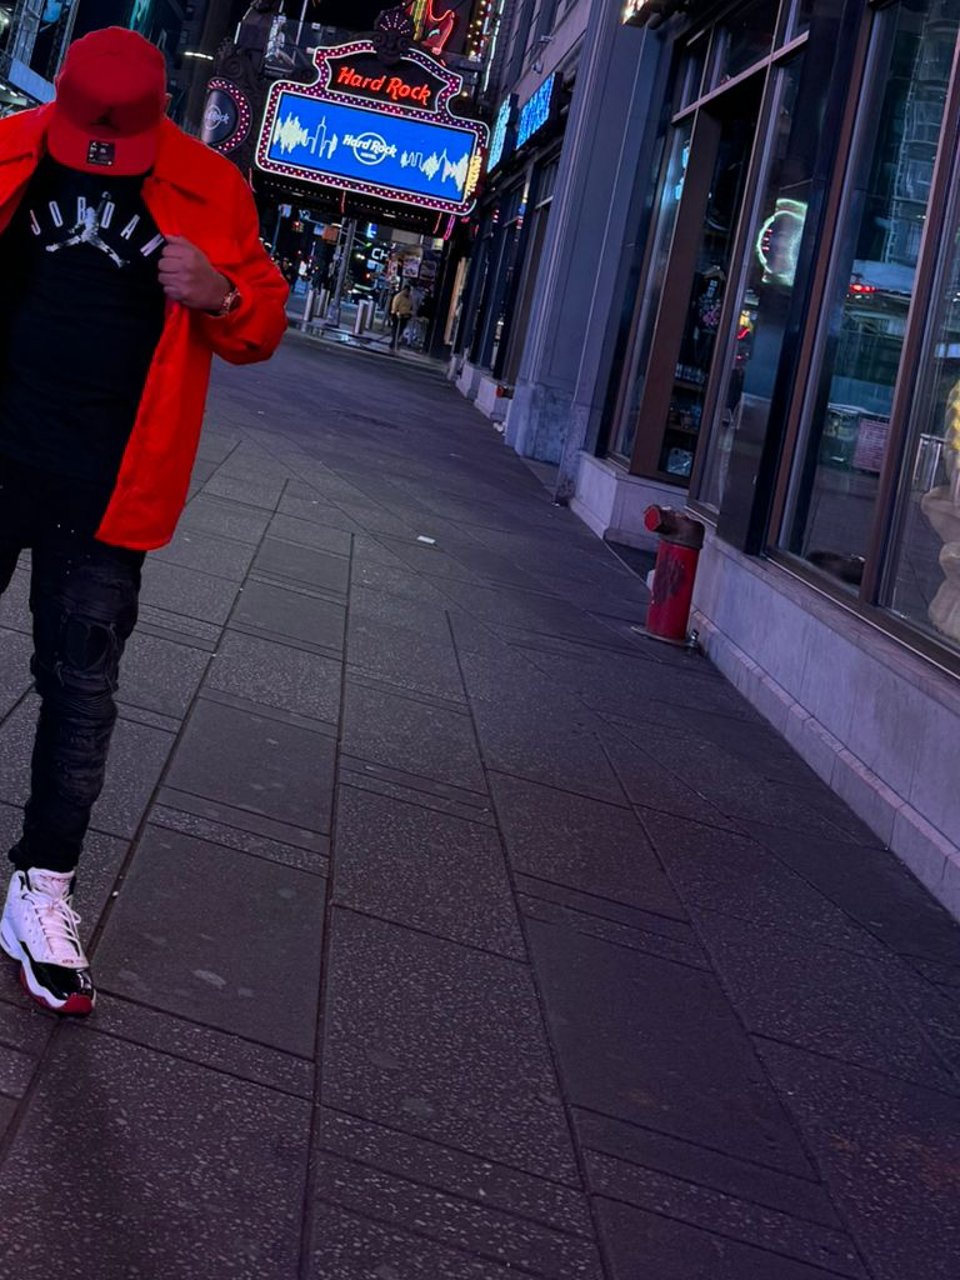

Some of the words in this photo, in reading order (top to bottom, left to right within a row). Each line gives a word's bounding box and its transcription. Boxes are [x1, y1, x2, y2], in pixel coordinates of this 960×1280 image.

[337, 67, 386, 92] Hard
[386, 77, 431, 106] Rock
[342, 134, 372, 150] Hard
[370, 140, 398, 158] Rock
[29, 195, 166, 257] JORDAN
